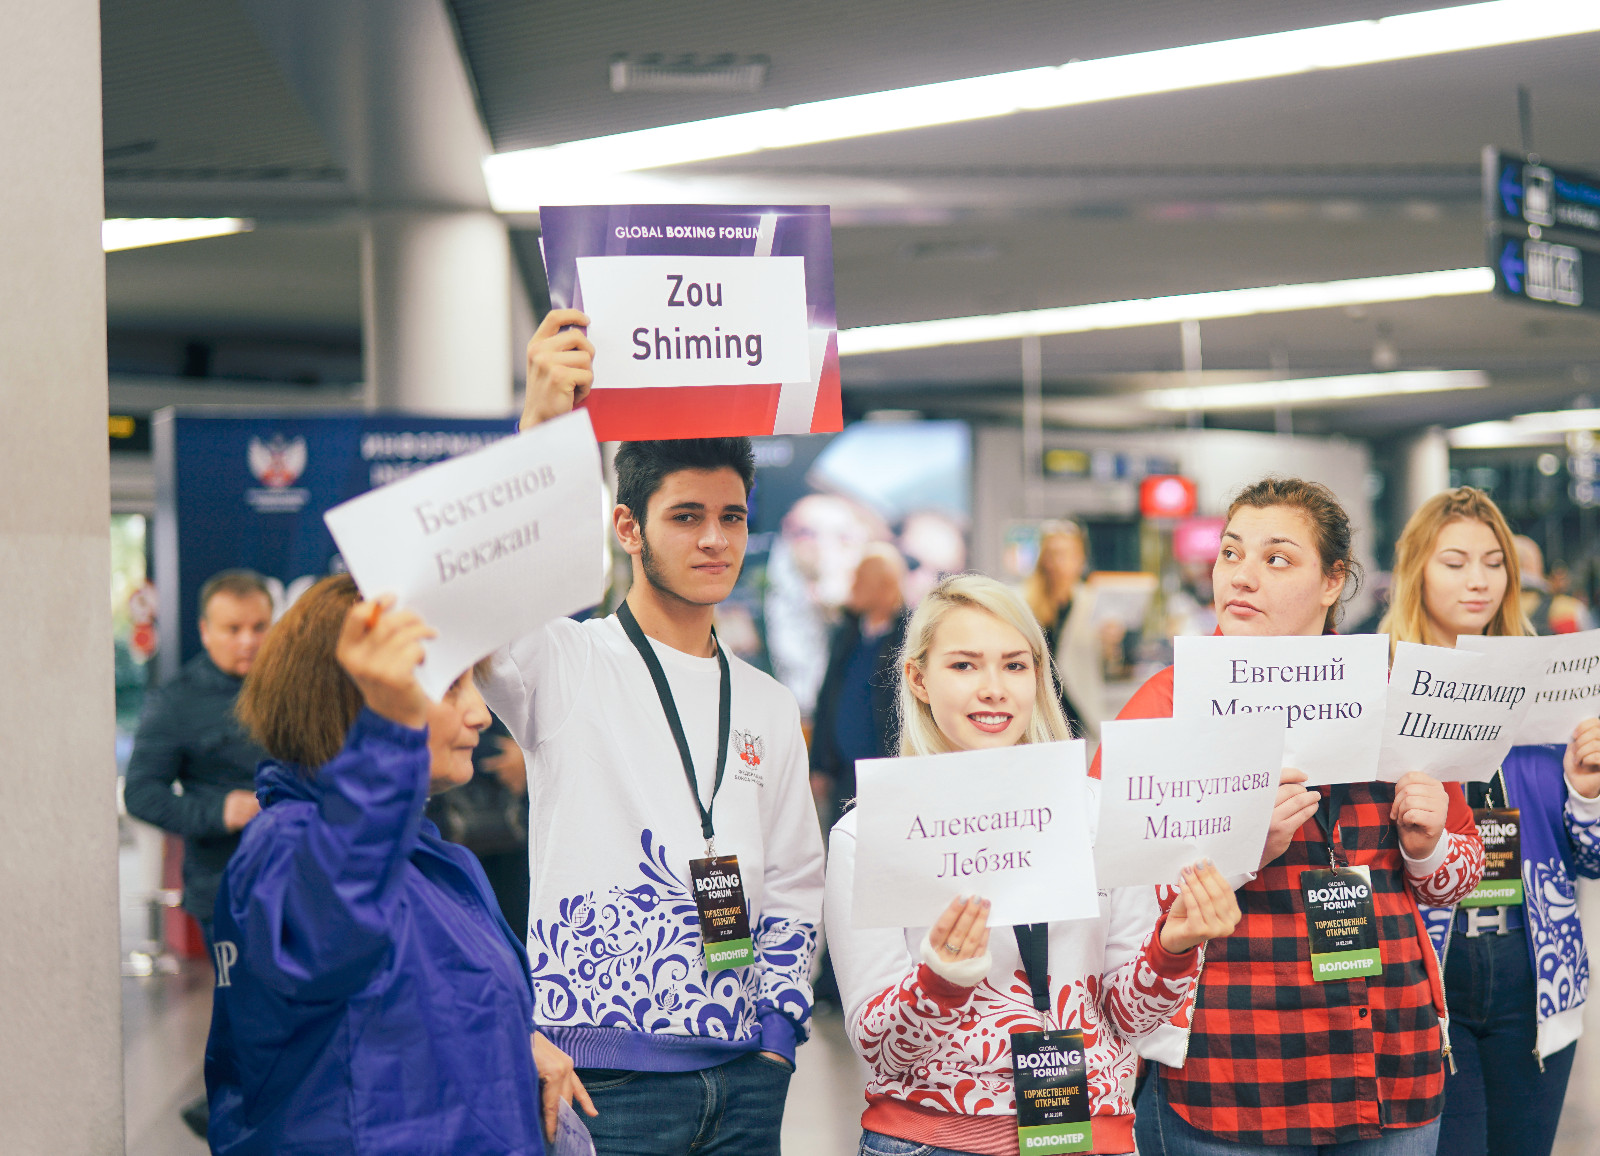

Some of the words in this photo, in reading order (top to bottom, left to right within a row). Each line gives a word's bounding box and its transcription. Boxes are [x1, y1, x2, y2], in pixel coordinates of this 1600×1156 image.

[615, 226, 663, 239] GLOBAL
[666, 226, 715, 239] BOXING
[719, 226, 763, 239] FORUM
[666, 274, 723, 307] Zou
[632, 326, 762, 366] Shiming
[414, 464, 556, 536] Бектенов
[434, 520, 541, 584] Бекжан
[1229, 656, 1346, 684] Евгений
[1411, 669, 1526, 710] Владимир
[1398, 711, 1502, 742] Шишкин
[1127, 771, 1271, 806] Шунгултаева
[906, 805, 1053, 840] Александр
[1144, 813, 1232, 841] Мадина
[937, 848, 1032, 878] Лебзяк
[695, 873, 740, 892] BOXING
[708, 889, 732, 899] FORUM
[1307, 884, 1369, 903] BOXING
[1323, 900, 1356, 911] FORUM
[1315, 917, 1368, 930] ТОРЖЕСТВЕННОЕ
[1325, 926, 1359, 937] ОТКРЫТИЕ
[710, 948, 749, 963] ВОЛОНТЕР
[1319, 958, 1374, 973] ВОЛОНТЕР
[1016, 1050, 1082, 1069] BOXING
[1033, 1066, 1068, 1078] FORUM
[1024, 1086, 1080, 1099] ТОРЖЕСТВЕННОЕ
[1035, 1096, 1070, 1108] ОТКРЫТИЕ
[1026, 1133, 1085, 1148] ВОЛОНТЕР
